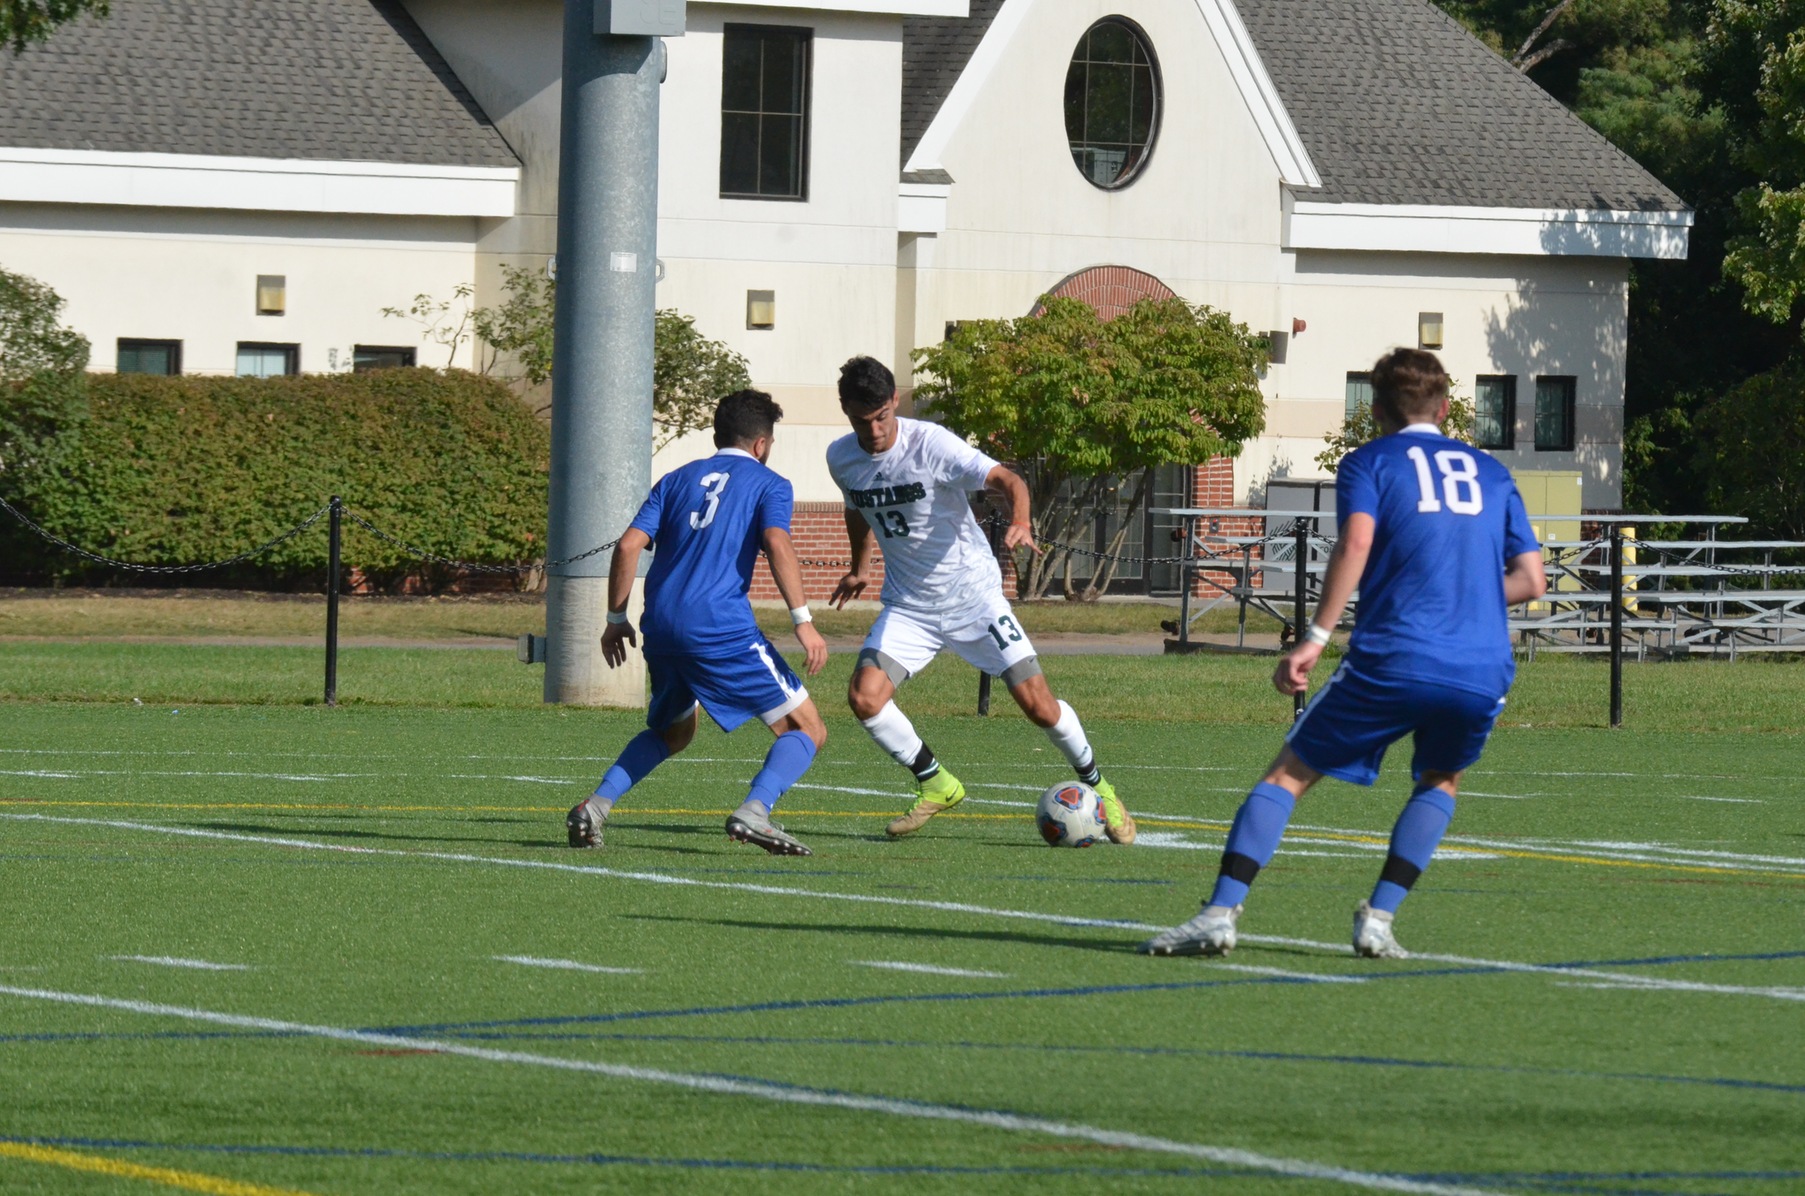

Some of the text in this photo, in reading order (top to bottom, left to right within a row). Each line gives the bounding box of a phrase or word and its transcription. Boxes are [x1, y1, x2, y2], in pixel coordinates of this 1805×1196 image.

[847, 481, 926, 508] USTANGS
[1406, 446, 1484, 516] 18
[690, 472, 730, 531] 3
[875, 510, 910, 539] 13
[987, 614, 1022, 651] 13
